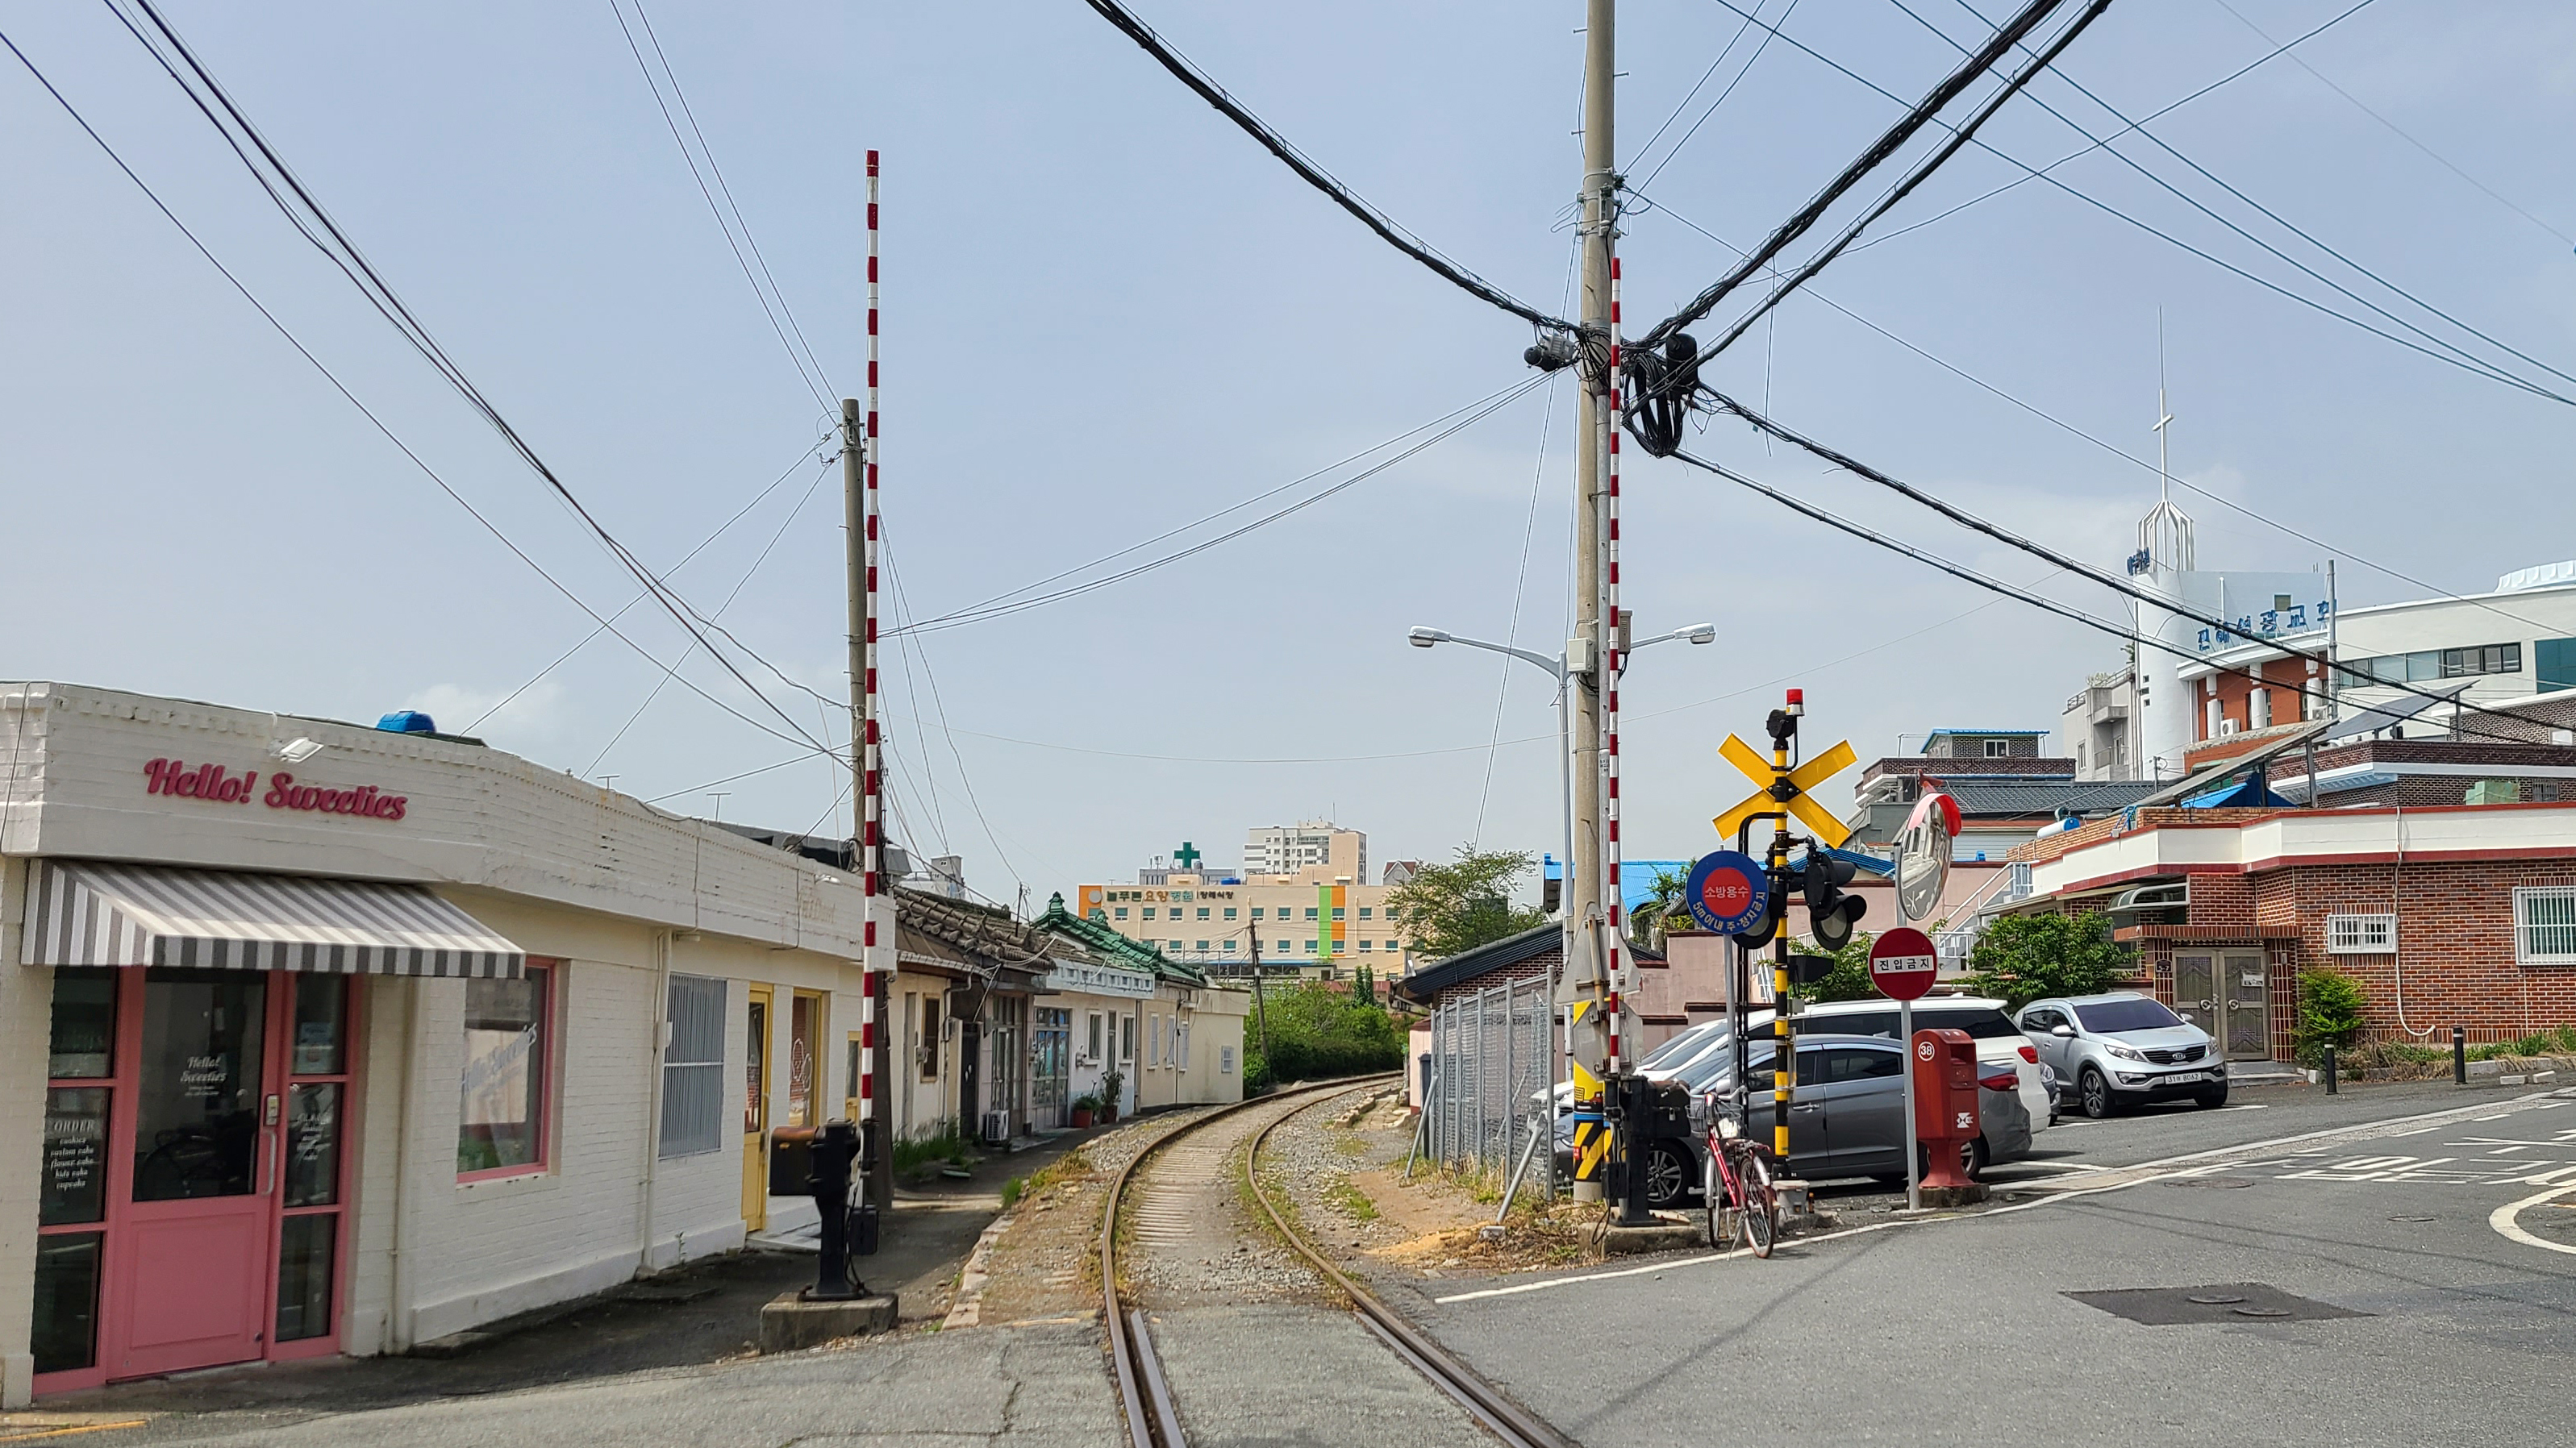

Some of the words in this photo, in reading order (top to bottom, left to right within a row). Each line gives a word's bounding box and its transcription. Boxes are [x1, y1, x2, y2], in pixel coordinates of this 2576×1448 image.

[144, 758, 258, 804] Hello!
[264, 772, 408, 821] Sweeties
[1704, 885, 1749, 899] 소방용수
[1692, 901, 1724, 931] 5m이내
[1879, 957, 1929, 972] 진입금지
[1920, 1045, 1932, 1056] 38
[54, 1119, 95, 1133] ORDER
